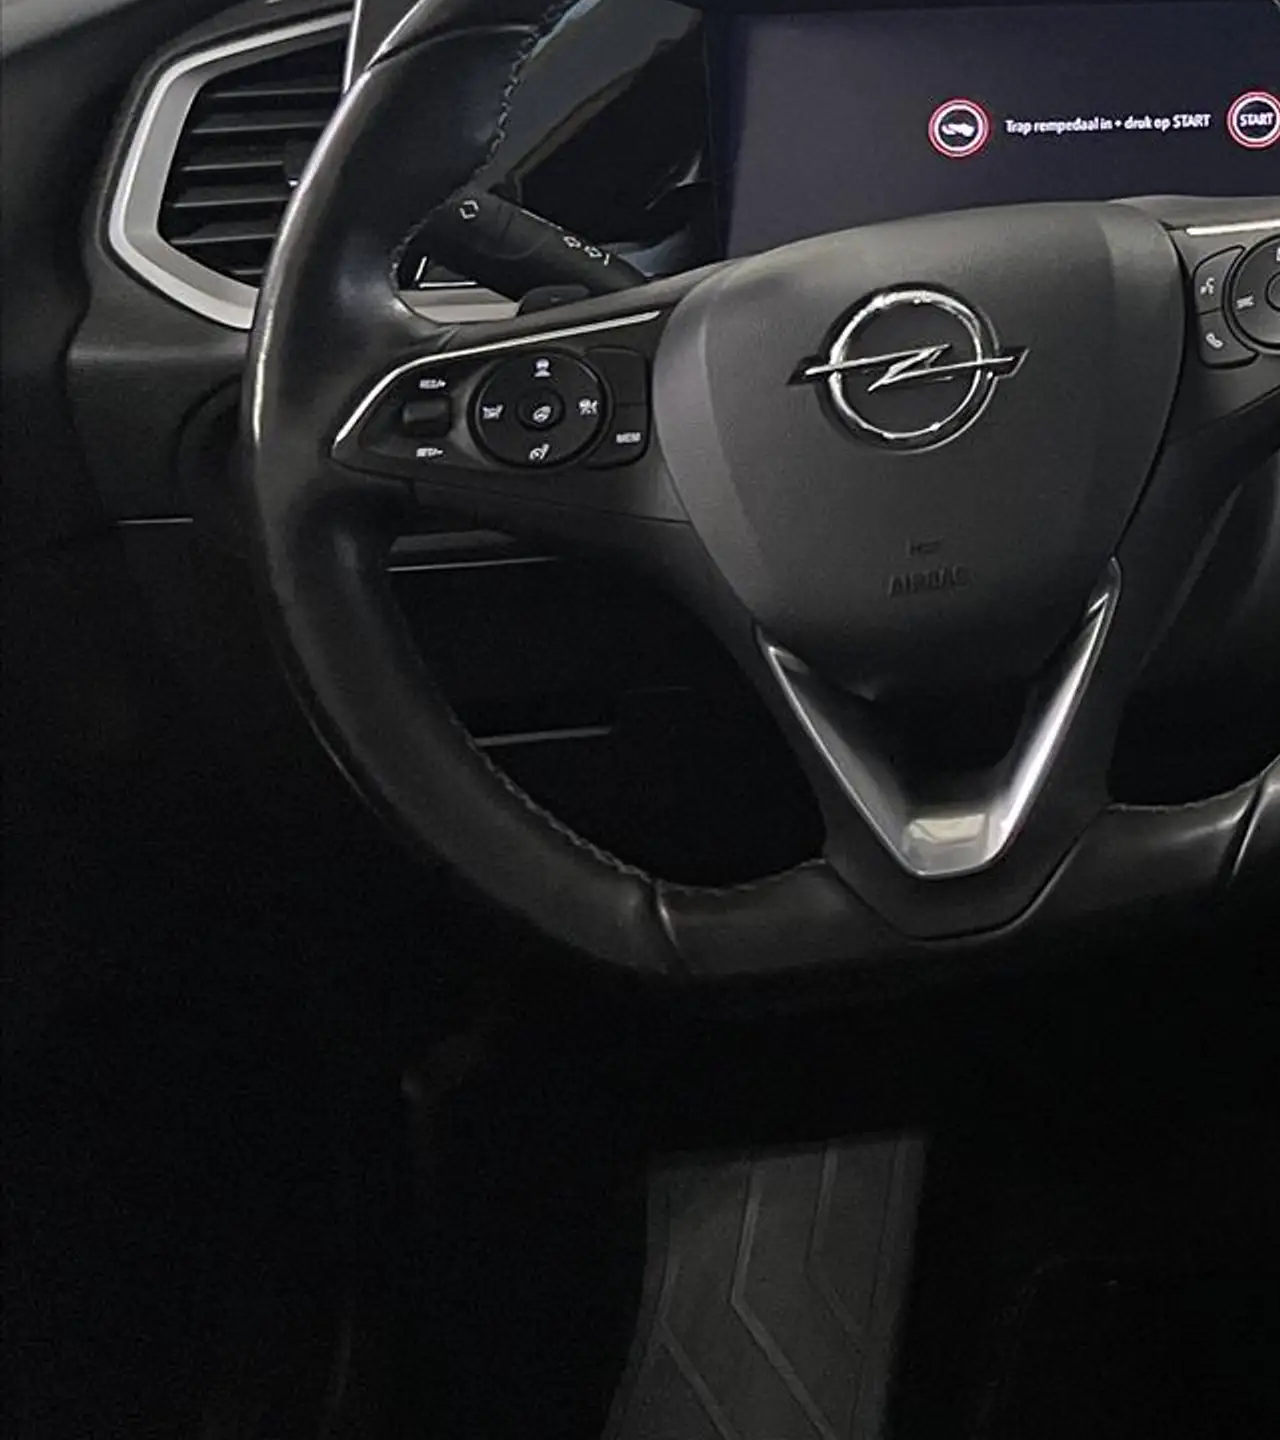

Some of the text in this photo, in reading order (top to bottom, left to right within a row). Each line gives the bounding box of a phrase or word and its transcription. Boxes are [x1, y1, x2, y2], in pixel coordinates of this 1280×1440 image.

[1005, 120, 1031, 136] Trap
[1034, 116, 1099, 136] rempedaal
[1101, 117, 1113, 130] in
[1125, 115, 1153, 131] druk
[1154, 118, 1171, 132] op
[1173, 114, 1211, 131] START
[1239, 113, 1275, 128] START
